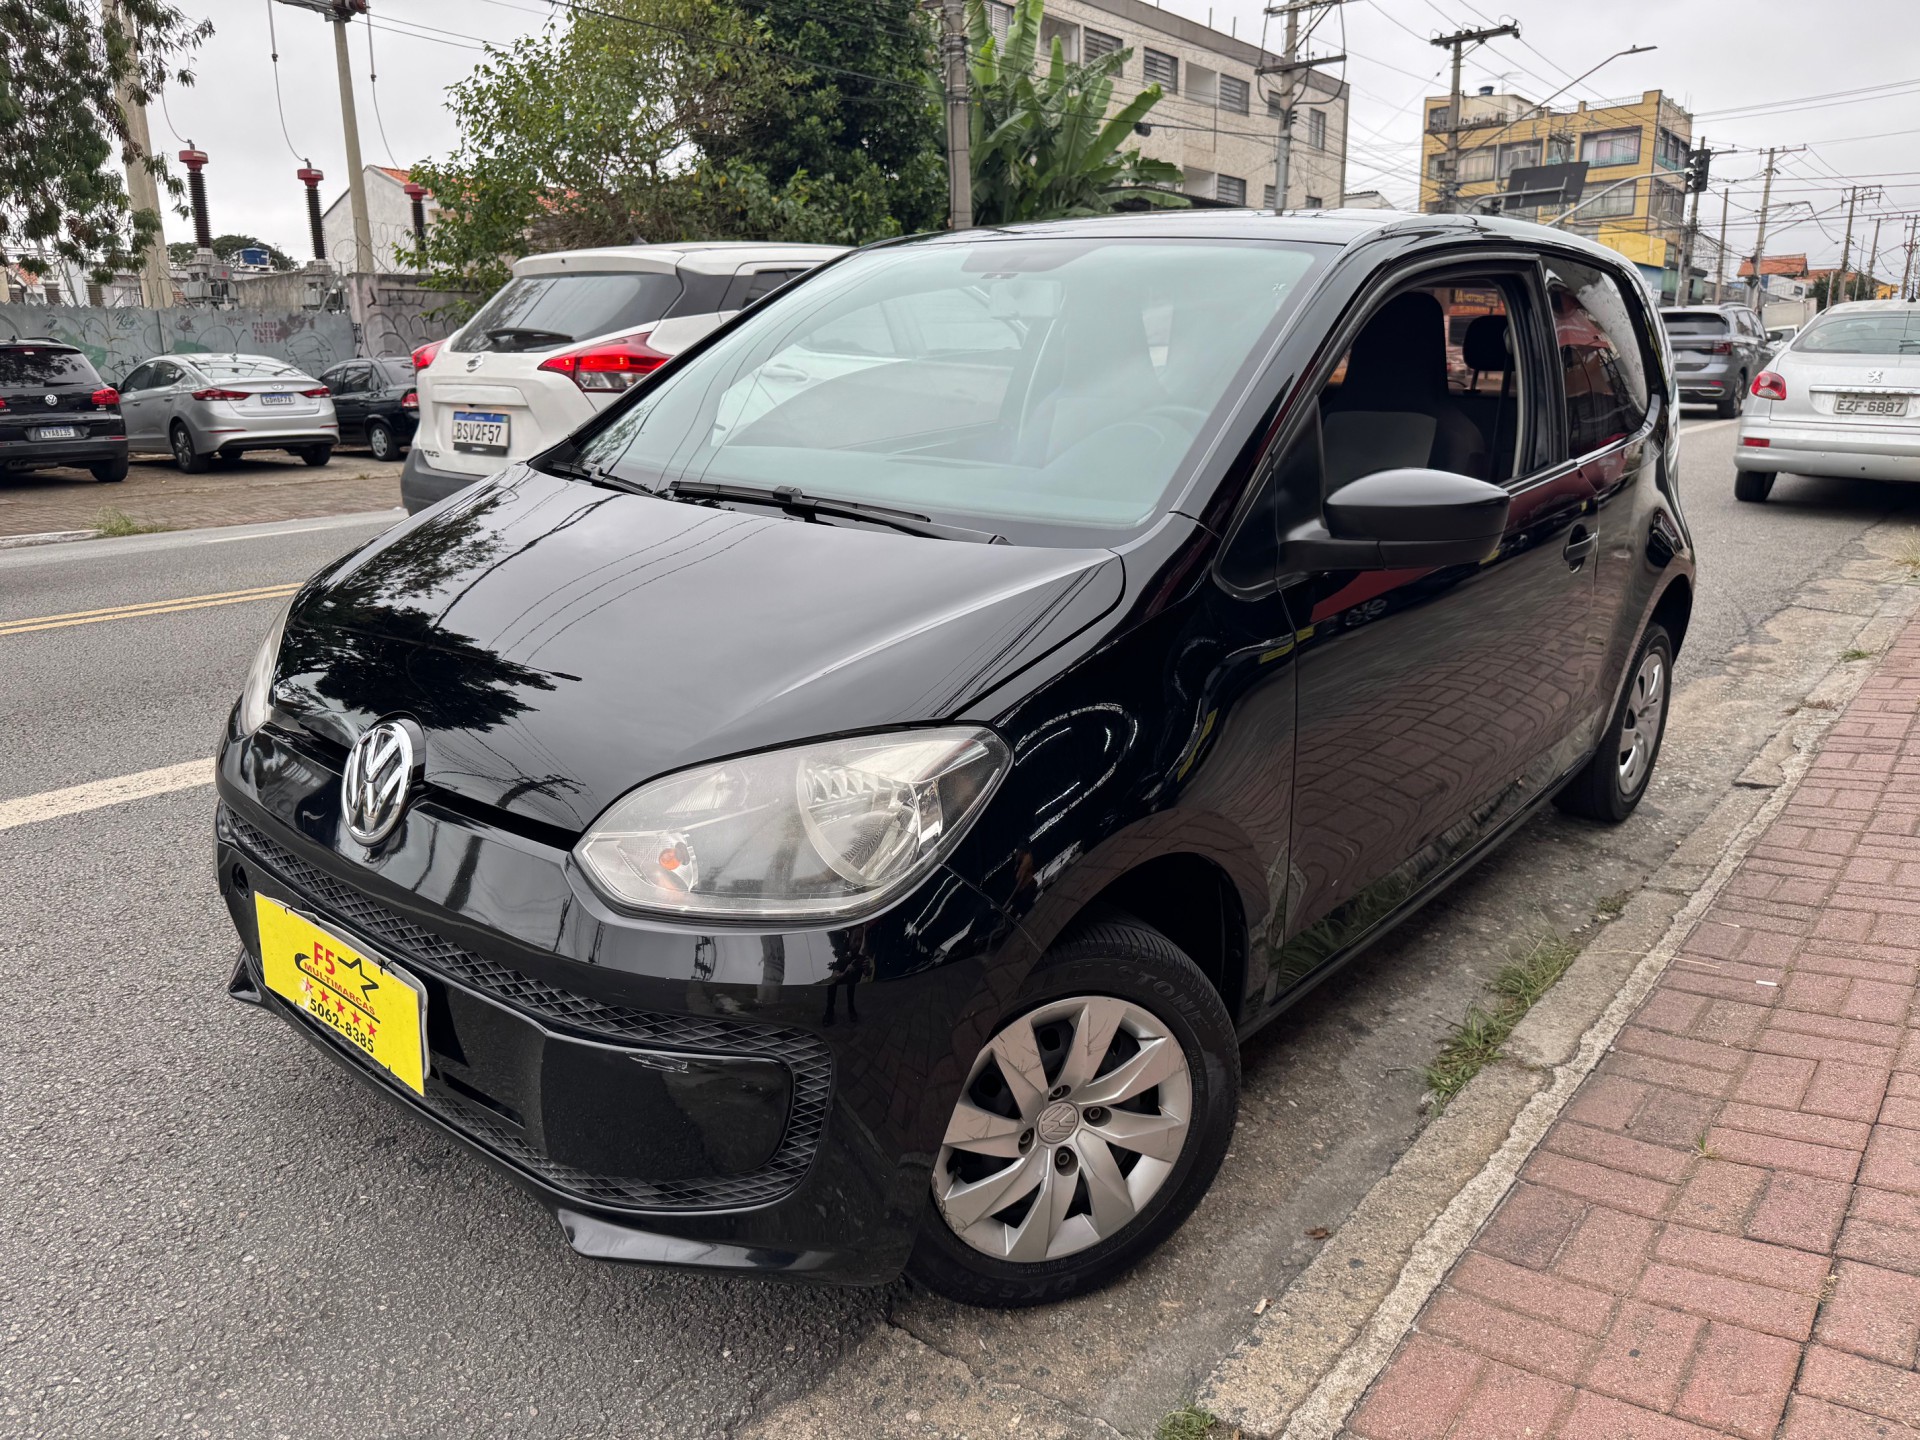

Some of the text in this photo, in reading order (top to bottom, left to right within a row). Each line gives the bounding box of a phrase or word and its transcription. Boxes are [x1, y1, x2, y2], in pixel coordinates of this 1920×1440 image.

[456, 422, 502, 443] BSV2F57
[313, 940, 336, 976] F5
[304, 961, 376, 1016] MULTIMARCAS
[310, 998, 375, 1054] 5062-8385
